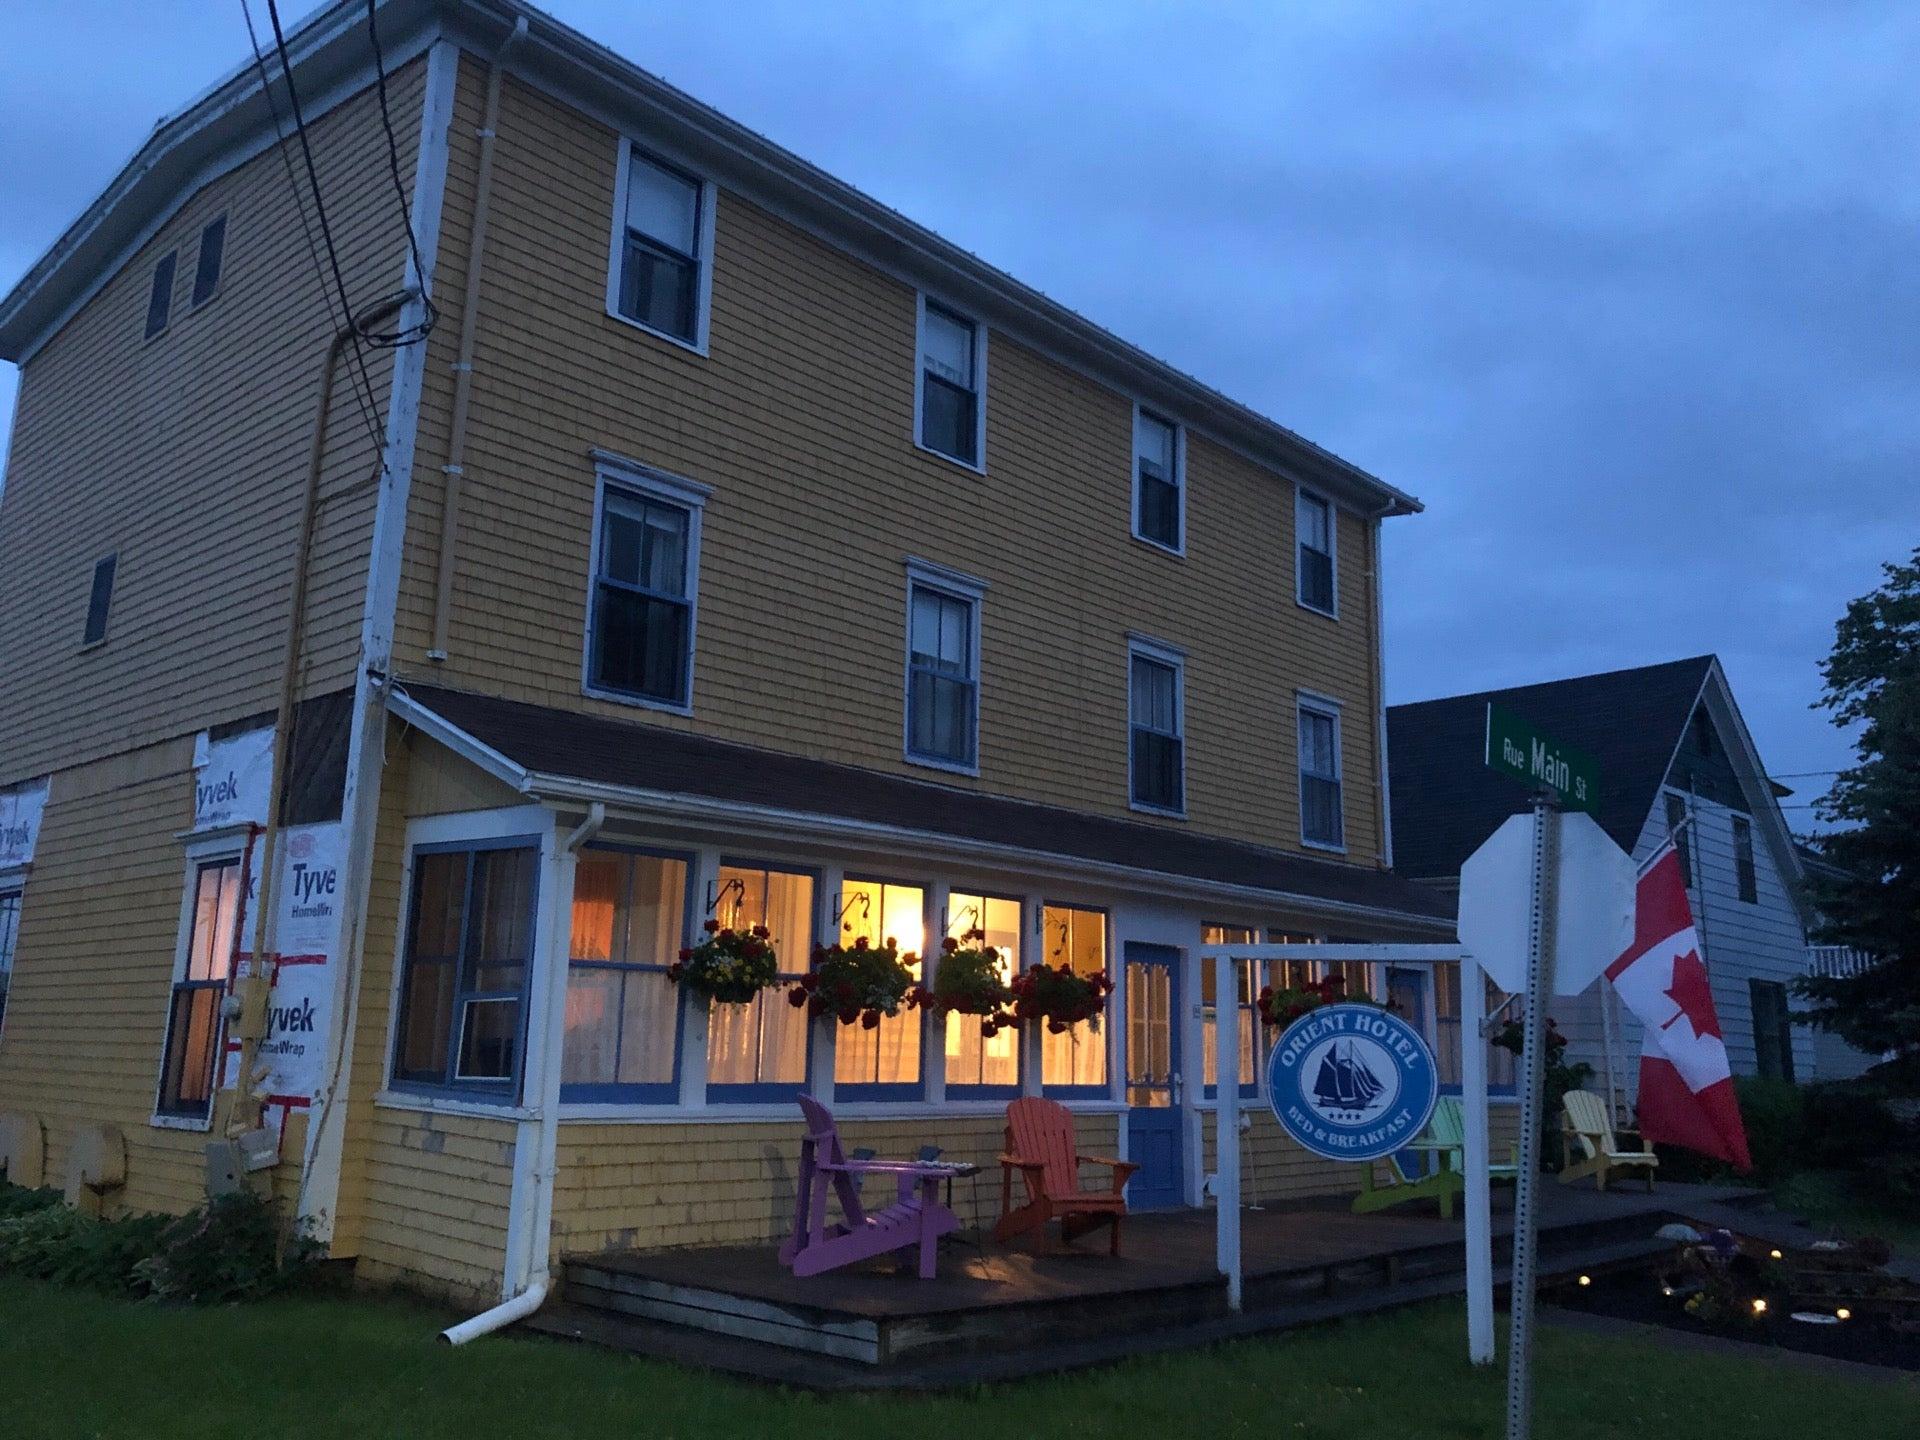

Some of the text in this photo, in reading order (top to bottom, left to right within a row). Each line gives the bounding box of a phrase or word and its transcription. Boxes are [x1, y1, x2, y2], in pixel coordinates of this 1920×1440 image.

[1503, 736, 1587, 801] Rue Main St
[196, 771, 237, 815] yvek
[266, 997, 315, 1039] yvek
[258, 1040, 305, 1058] omeWrap
[1281, 1013, 1420, 1069] ORIENT HOTEL
[1287, 1106, 1413, 1149] BED & BREAKFAST
